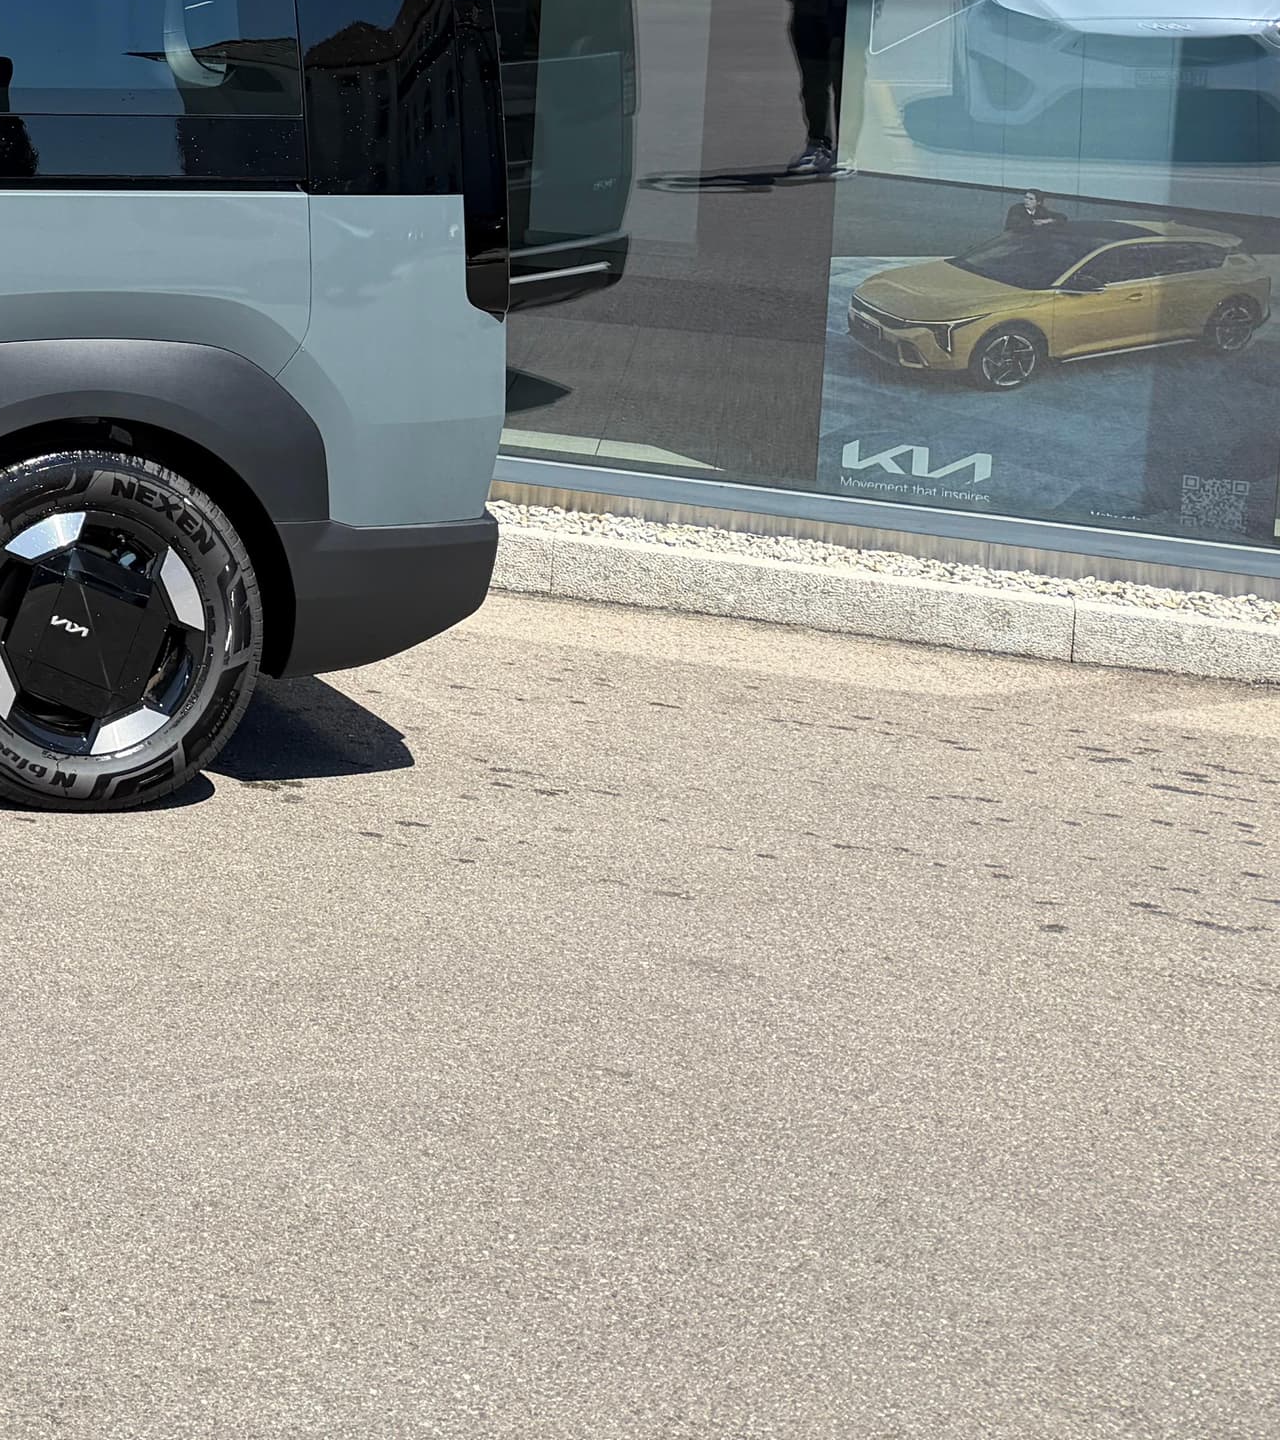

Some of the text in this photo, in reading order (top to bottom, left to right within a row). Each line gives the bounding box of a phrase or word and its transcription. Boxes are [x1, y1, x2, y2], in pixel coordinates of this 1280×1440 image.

[842, 439, 993, 483] KIA
[912, 483, 938, 498] that
[111, 478, 216, 555] NEXEN
[51, 615, 89, 637] KIA
